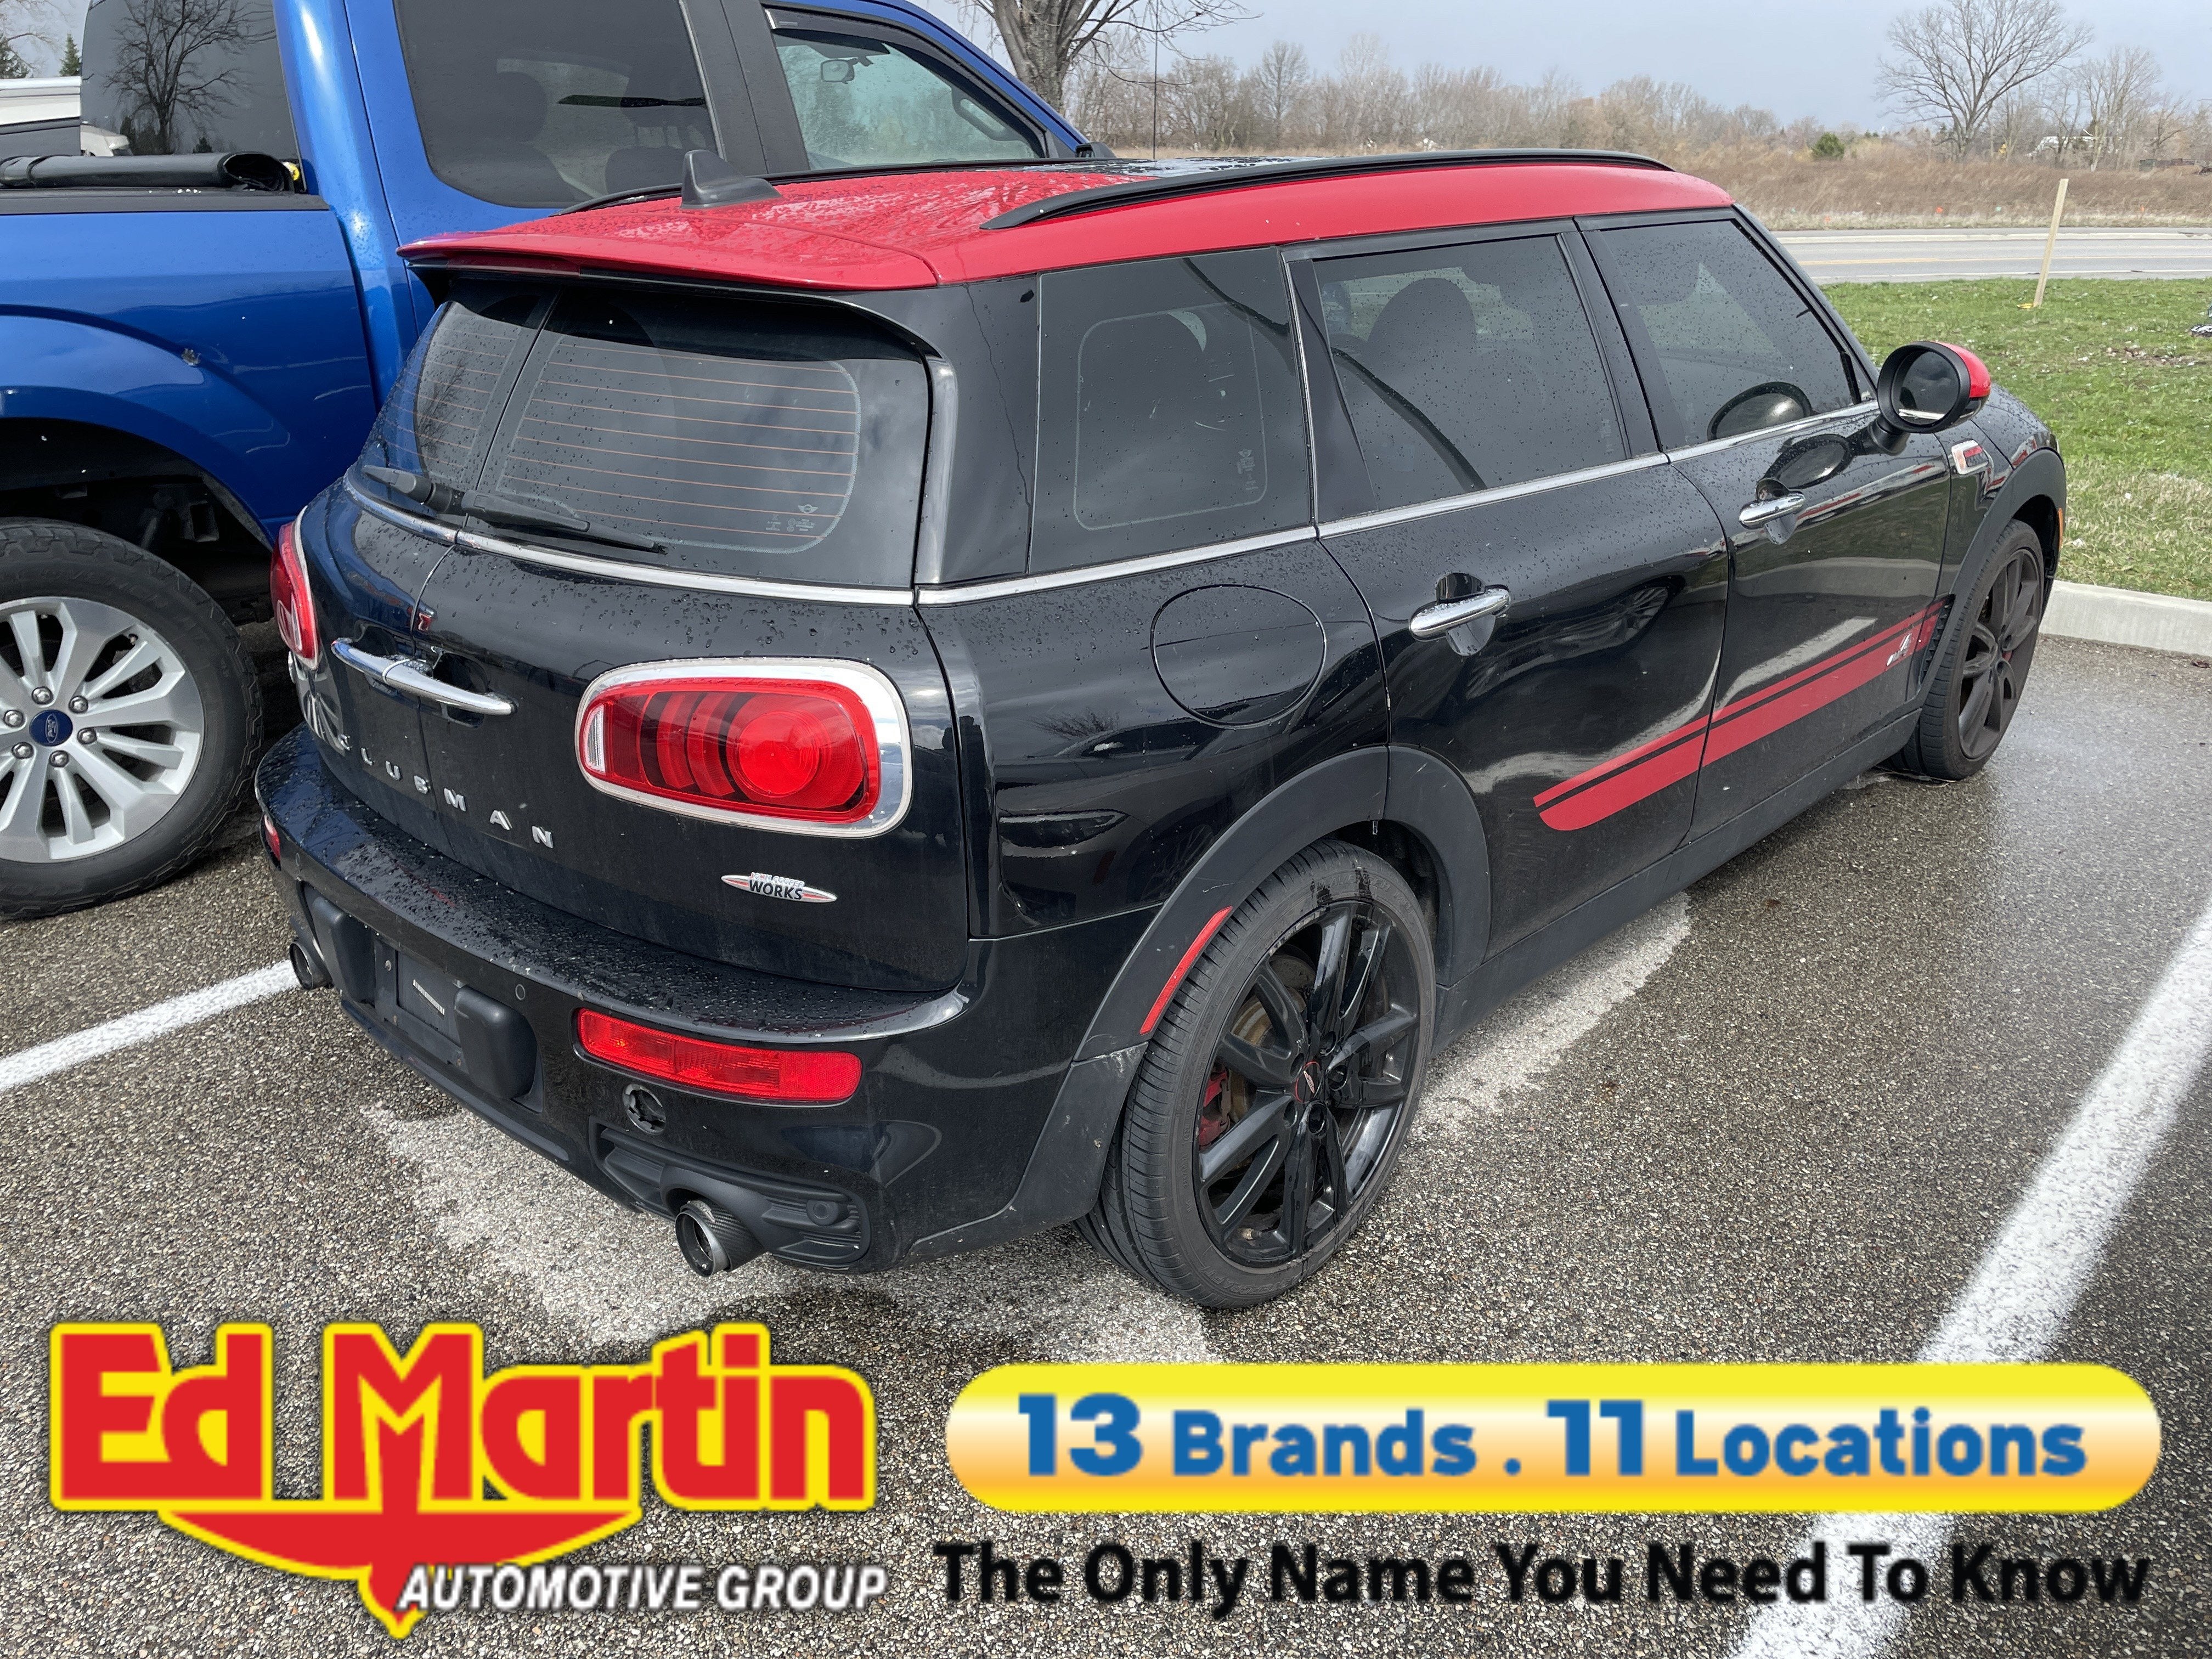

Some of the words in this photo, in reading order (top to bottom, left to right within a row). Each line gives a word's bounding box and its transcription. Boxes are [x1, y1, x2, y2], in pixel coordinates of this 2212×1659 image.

[337, 733, 554, 849] CLUBMAN
[749, 879, 803, 900] WORKS
[772, 876, 805, 888] COOPER
